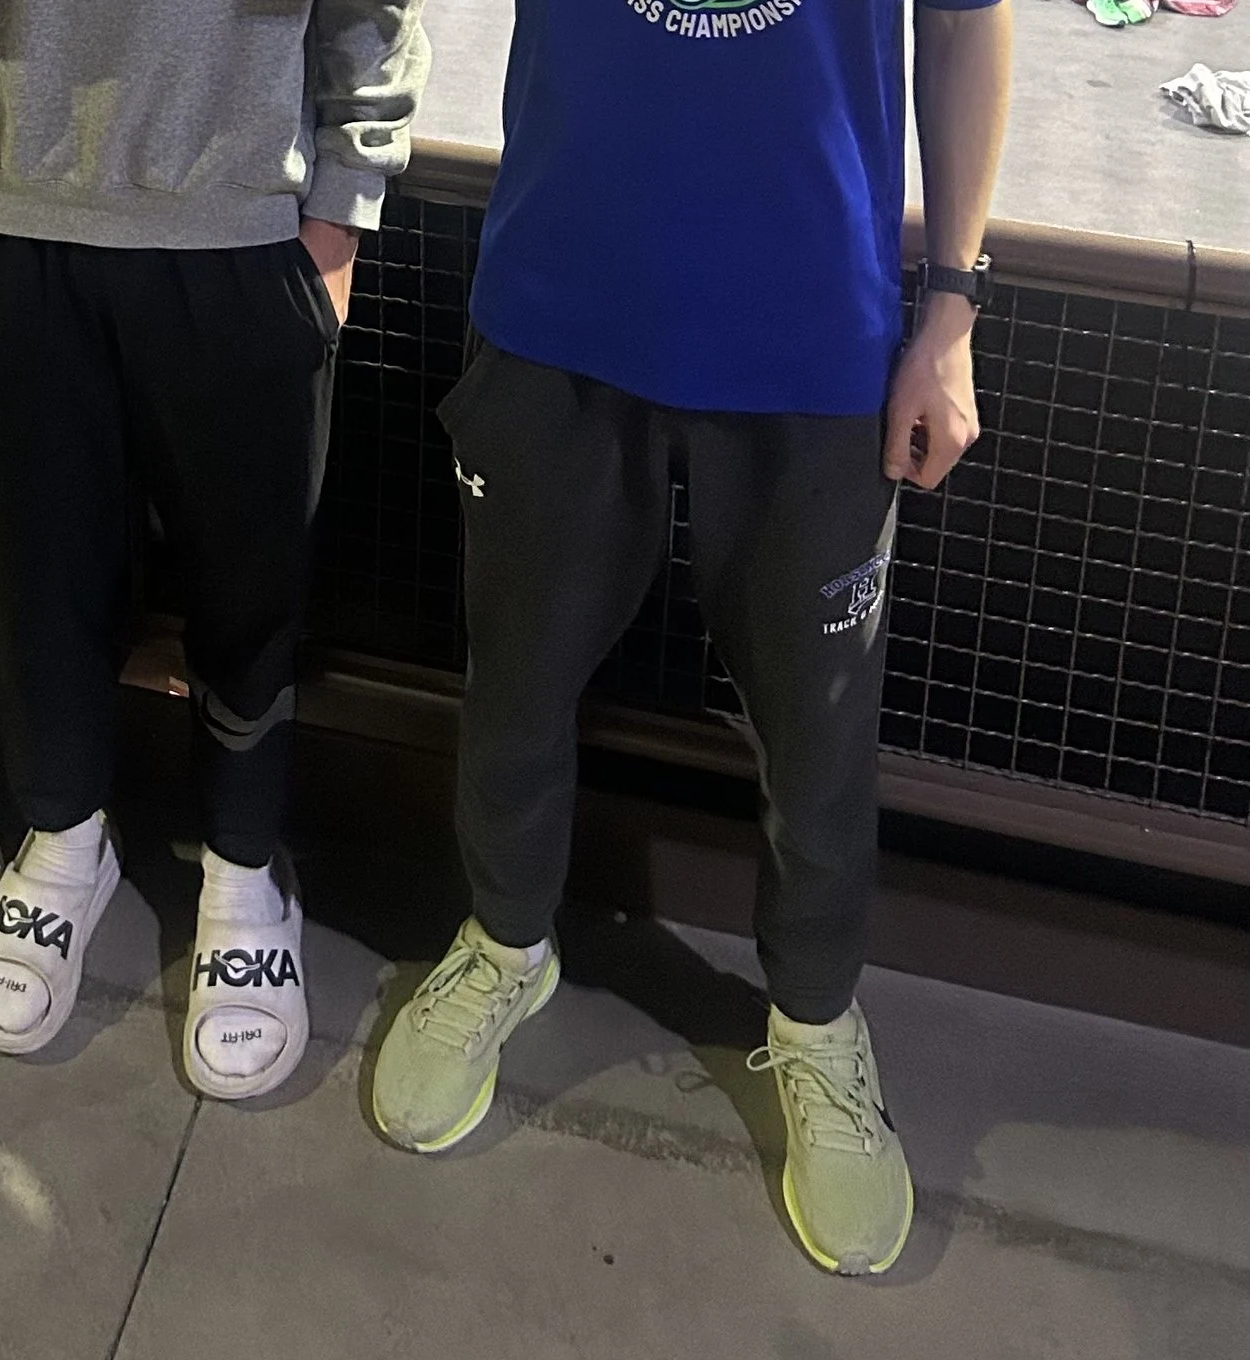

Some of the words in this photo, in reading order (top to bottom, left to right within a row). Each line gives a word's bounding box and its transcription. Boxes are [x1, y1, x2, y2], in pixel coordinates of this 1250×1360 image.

[823, 616, 857, 634] TRACK
[193, 949, 300, 990] HOKA
[221, 1028, 261, 1043] DRI-FIT
